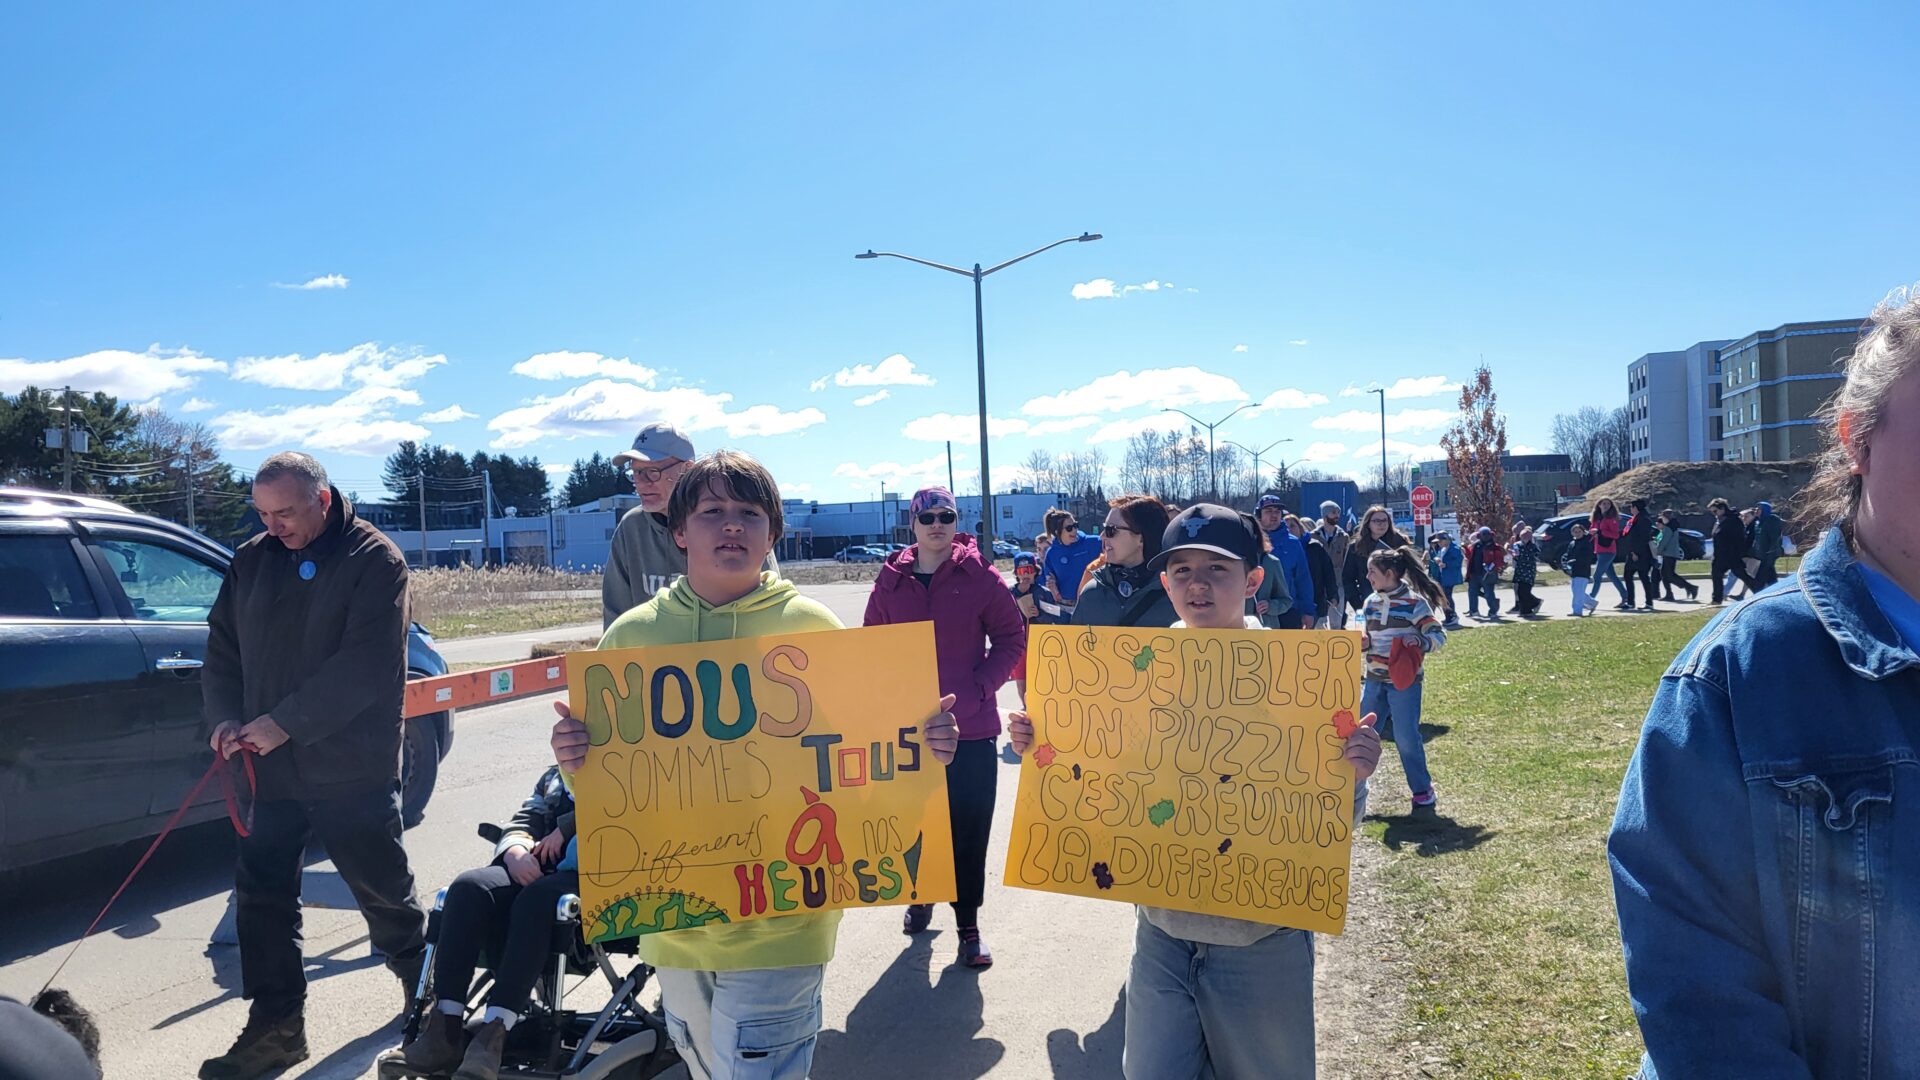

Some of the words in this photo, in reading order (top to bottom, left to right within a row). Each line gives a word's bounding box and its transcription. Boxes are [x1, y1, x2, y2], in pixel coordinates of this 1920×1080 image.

[1412, 493, 1433, 501] ARRÊT
[584, 644, 813, 746] NOUS
[1034, 629, 1356, 710] ASSEMBLER
[601, 740, 772, 818] SOMMES
[801, 726, 921, 792] TOUS
[1043, 698, 1123, 759] UN
[1145, 706, 1348, 791] PUZZLE
[1040, 763, 1155, 828] C'EST
[733, 830, 923, 916] HEURES!
[1019, 822, 1092, 886] LA
